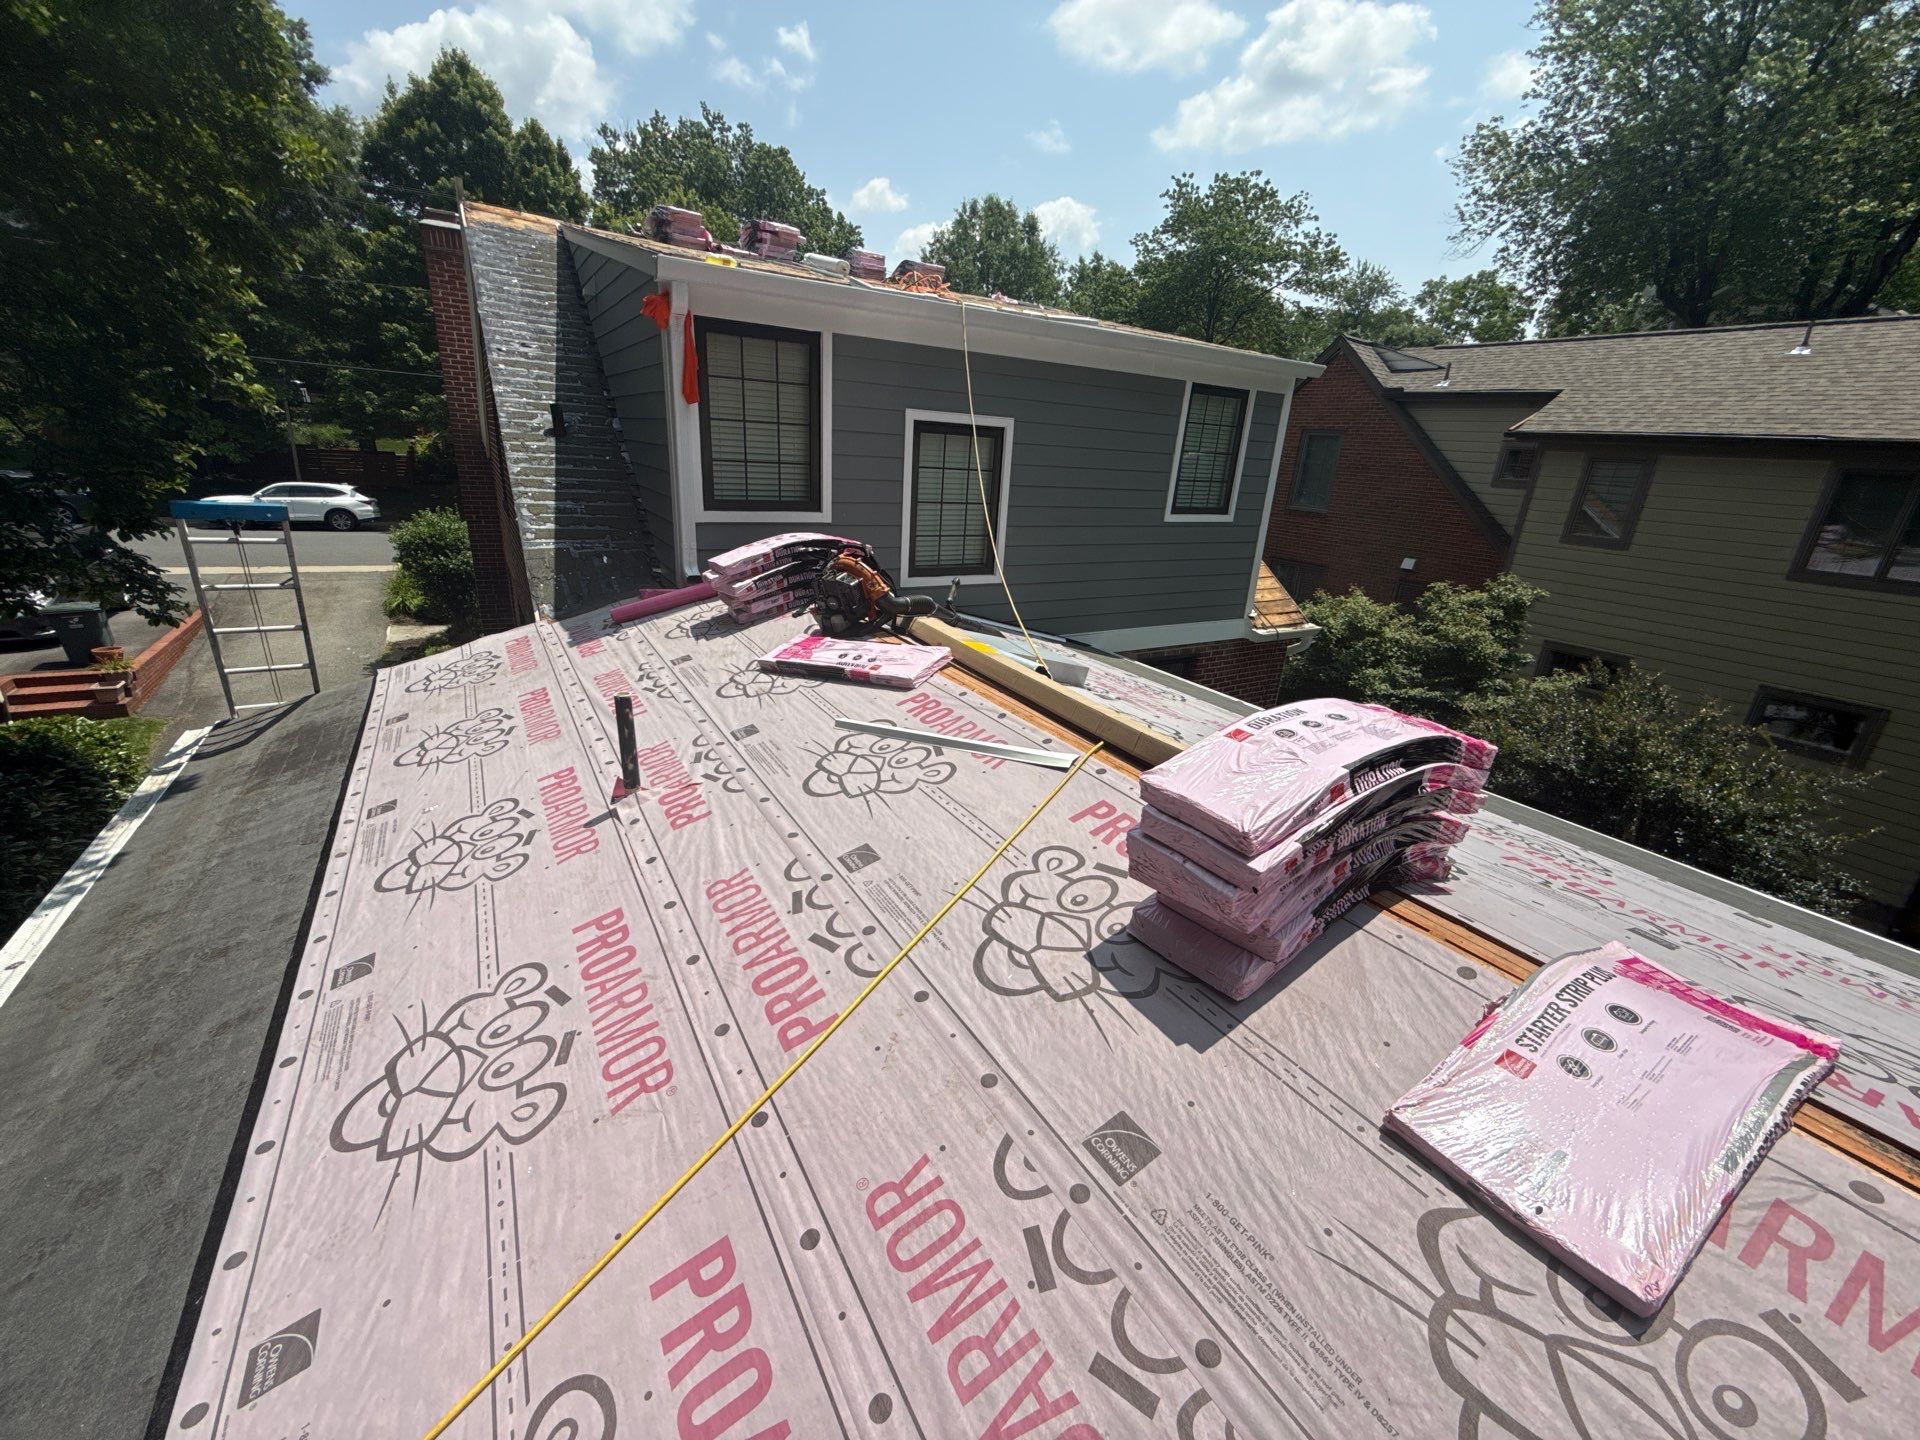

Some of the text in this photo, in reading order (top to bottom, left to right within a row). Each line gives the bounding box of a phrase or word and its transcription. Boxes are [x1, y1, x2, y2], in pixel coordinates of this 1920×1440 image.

[518, 687, 561, 746] PROARMOR
[1247, 707, 1307, 730] DURATION
[537, 766, 600, 865] PROARMOR
[1515, 1001, 1571, 1053] STARTER
[1555, 972, 1596, 1008] STRIP
[1091, 1136, 1132, 1181] CORNING
[1104, 1136, 1138, 1173] OWENS
[1186, 1208, 1214, 1238] ASPHALT
[1244, 1272, 1266, 1294] ASTM
[1281, 1311, 1303, 1334] TYPE
[1332, 1367, 1356, 1391] TYPE
[1353, 1389, 1364, 1400] IV
[1362, 1399, 1372, 1409] &
[1192, 1203, 1213, 1225] MEETS
[1212, 1224, 1231, 1244] ASTM
[1244, 1258, 1267, 1283] CLASS
[1265, 1281, 1274, 1289] A
[1271, 1287, 1297, 1314] (WHEN
[1295, 1312, 1336, 1356] INSTALLED
[1333, 1354, 1363, 1385] UNDER
[649, 1234, 791, 1440] PRO
